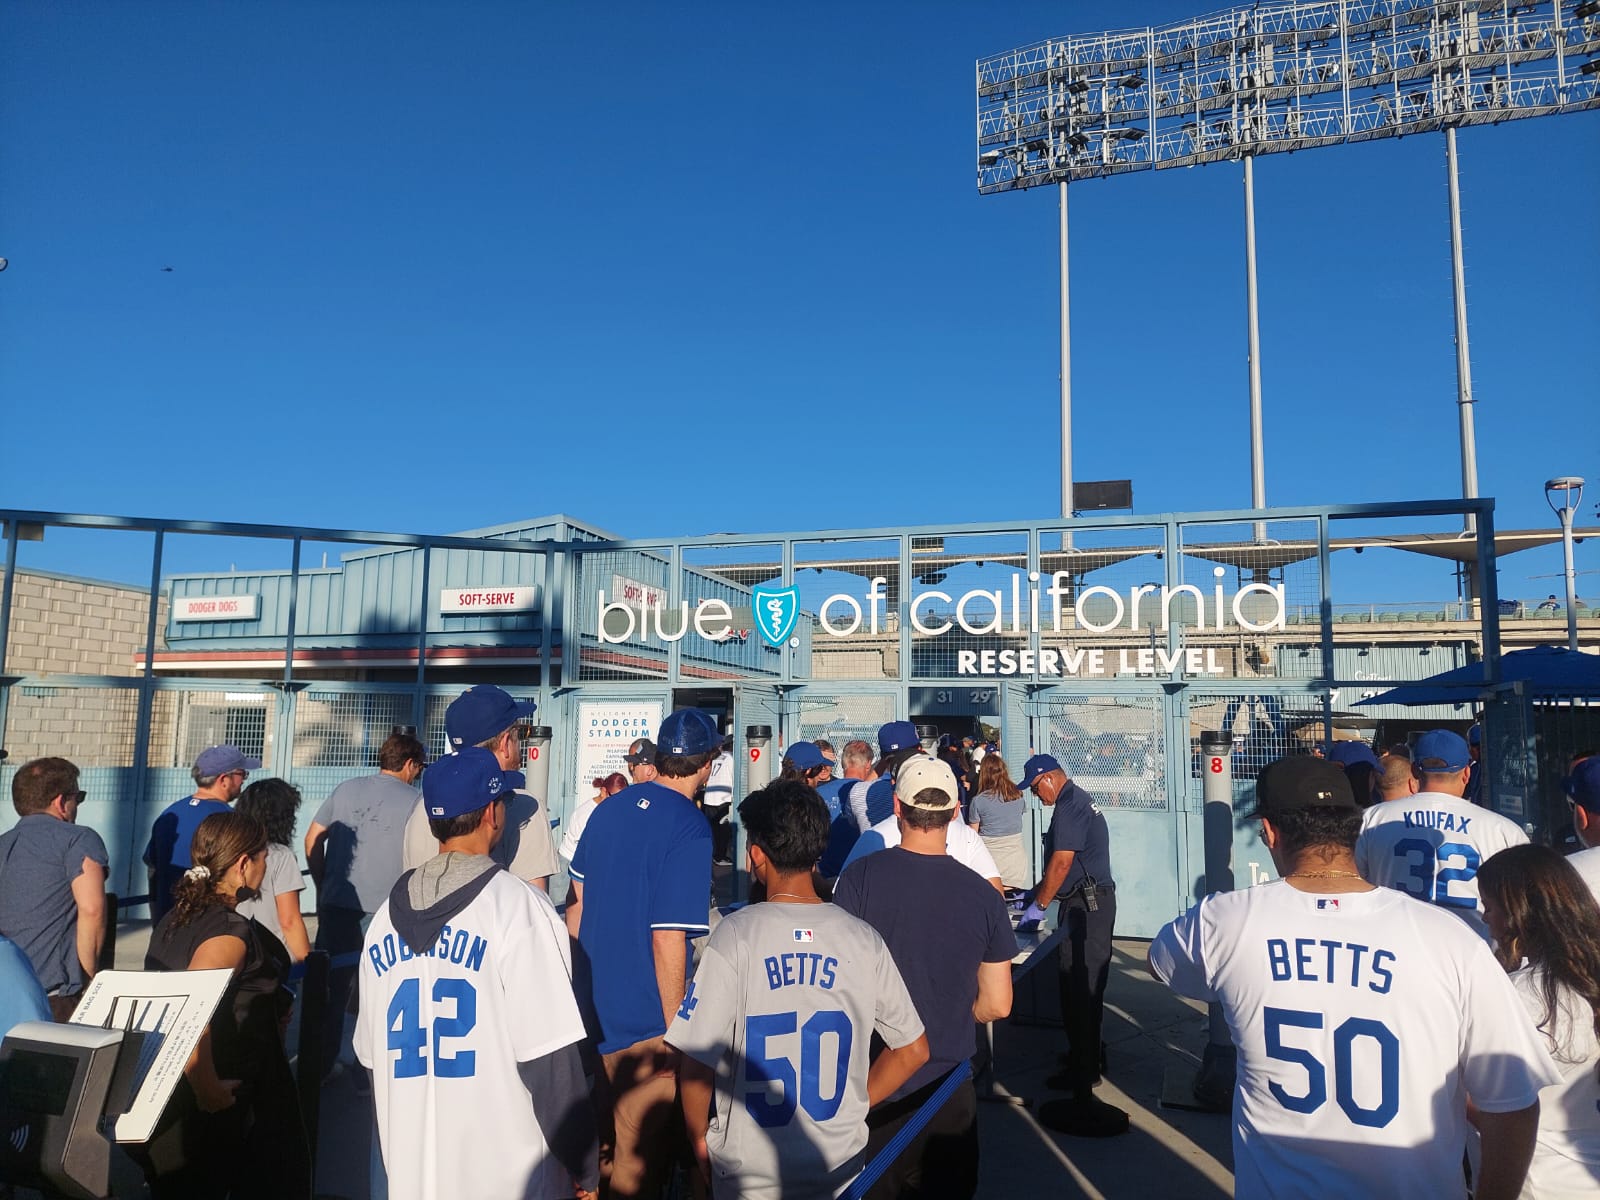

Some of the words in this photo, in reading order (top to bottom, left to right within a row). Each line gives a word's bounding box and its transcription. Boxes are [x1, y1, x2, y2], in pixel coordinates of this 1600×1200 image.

[188, 601, 216, 614] DODGER
[218, 600, 239, 613] DOGS
[459, 592, 515, 606] SOFT-SERVE
[598, 589, 733, 645] blue
[819, 576, 887, 637] of
[910, 566, 1286, 636] california
[958, 649, 1105, 675] RESERVE
[1120, 646, 1224, 674] LEVEL
[937, 691, 953, 704] 31
[969, 691, 990, 704] 29
[591, 719, 647, 727] DODGER
[589, 729, 650, 738] STADIUM
[528, 747, 539, 761] 10
[750, 748, 760, 763] 9
[1210, 757, 1223, 774] 8
[1403, 811, 1471, 835] KOUFAX
[1394, 838, 1480, 910] 32
[764, 952, 838, 991] BETTS
[1267, 937, 1397, 995] BETTS
[387, 978, 477, 1079] 42
[745, 1010, 853, 1127] 50
[1263, 1006, 1400, 1129] 50
